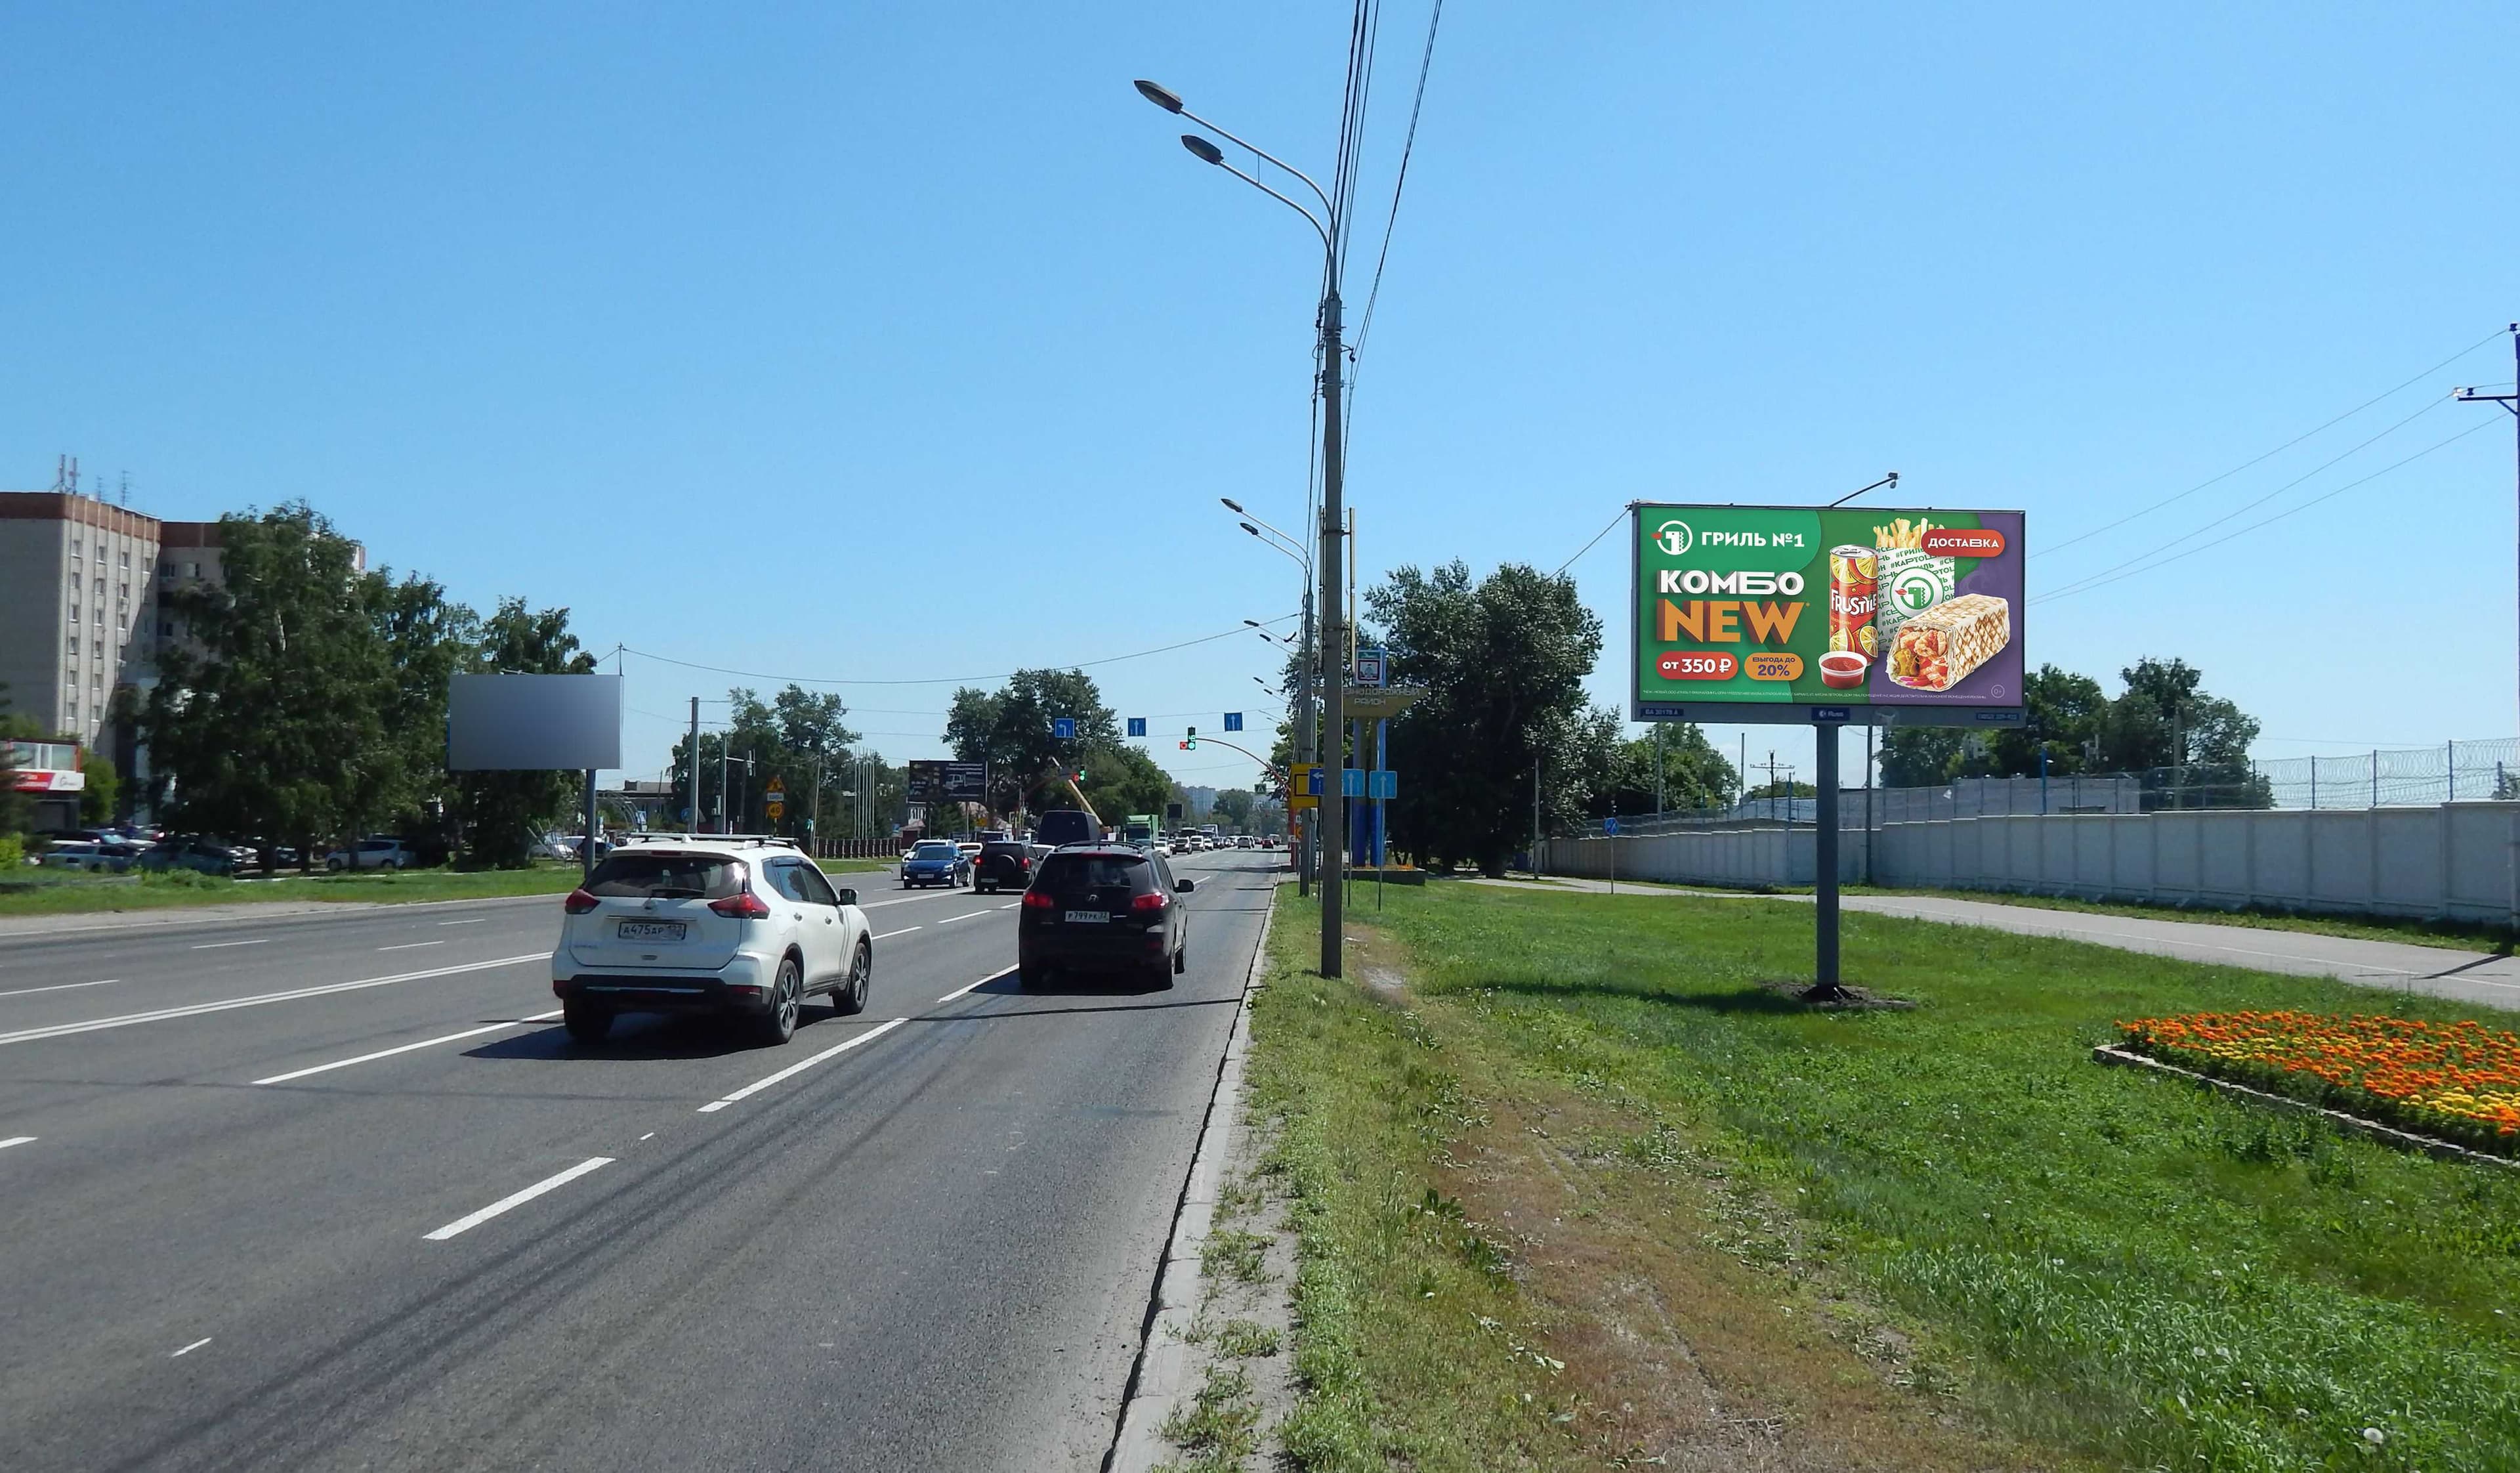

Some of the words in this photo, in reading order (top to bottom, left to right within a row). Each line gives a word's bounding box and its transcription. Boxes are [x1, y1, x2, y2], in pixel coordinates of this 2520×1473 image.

[1701, 531, 1767, 547] ГРИЛЬ
[1773, 532, 1805, 547] №1
[1928, 538, 2000, 548] ДОСТАВКА
[1658, 569, 1805, 596] КОМБО
[1658, 598, 1805, 645] NEW
[1681, 658, 1716, 673] 350
[1757, 664, 1790, 677] 20%
